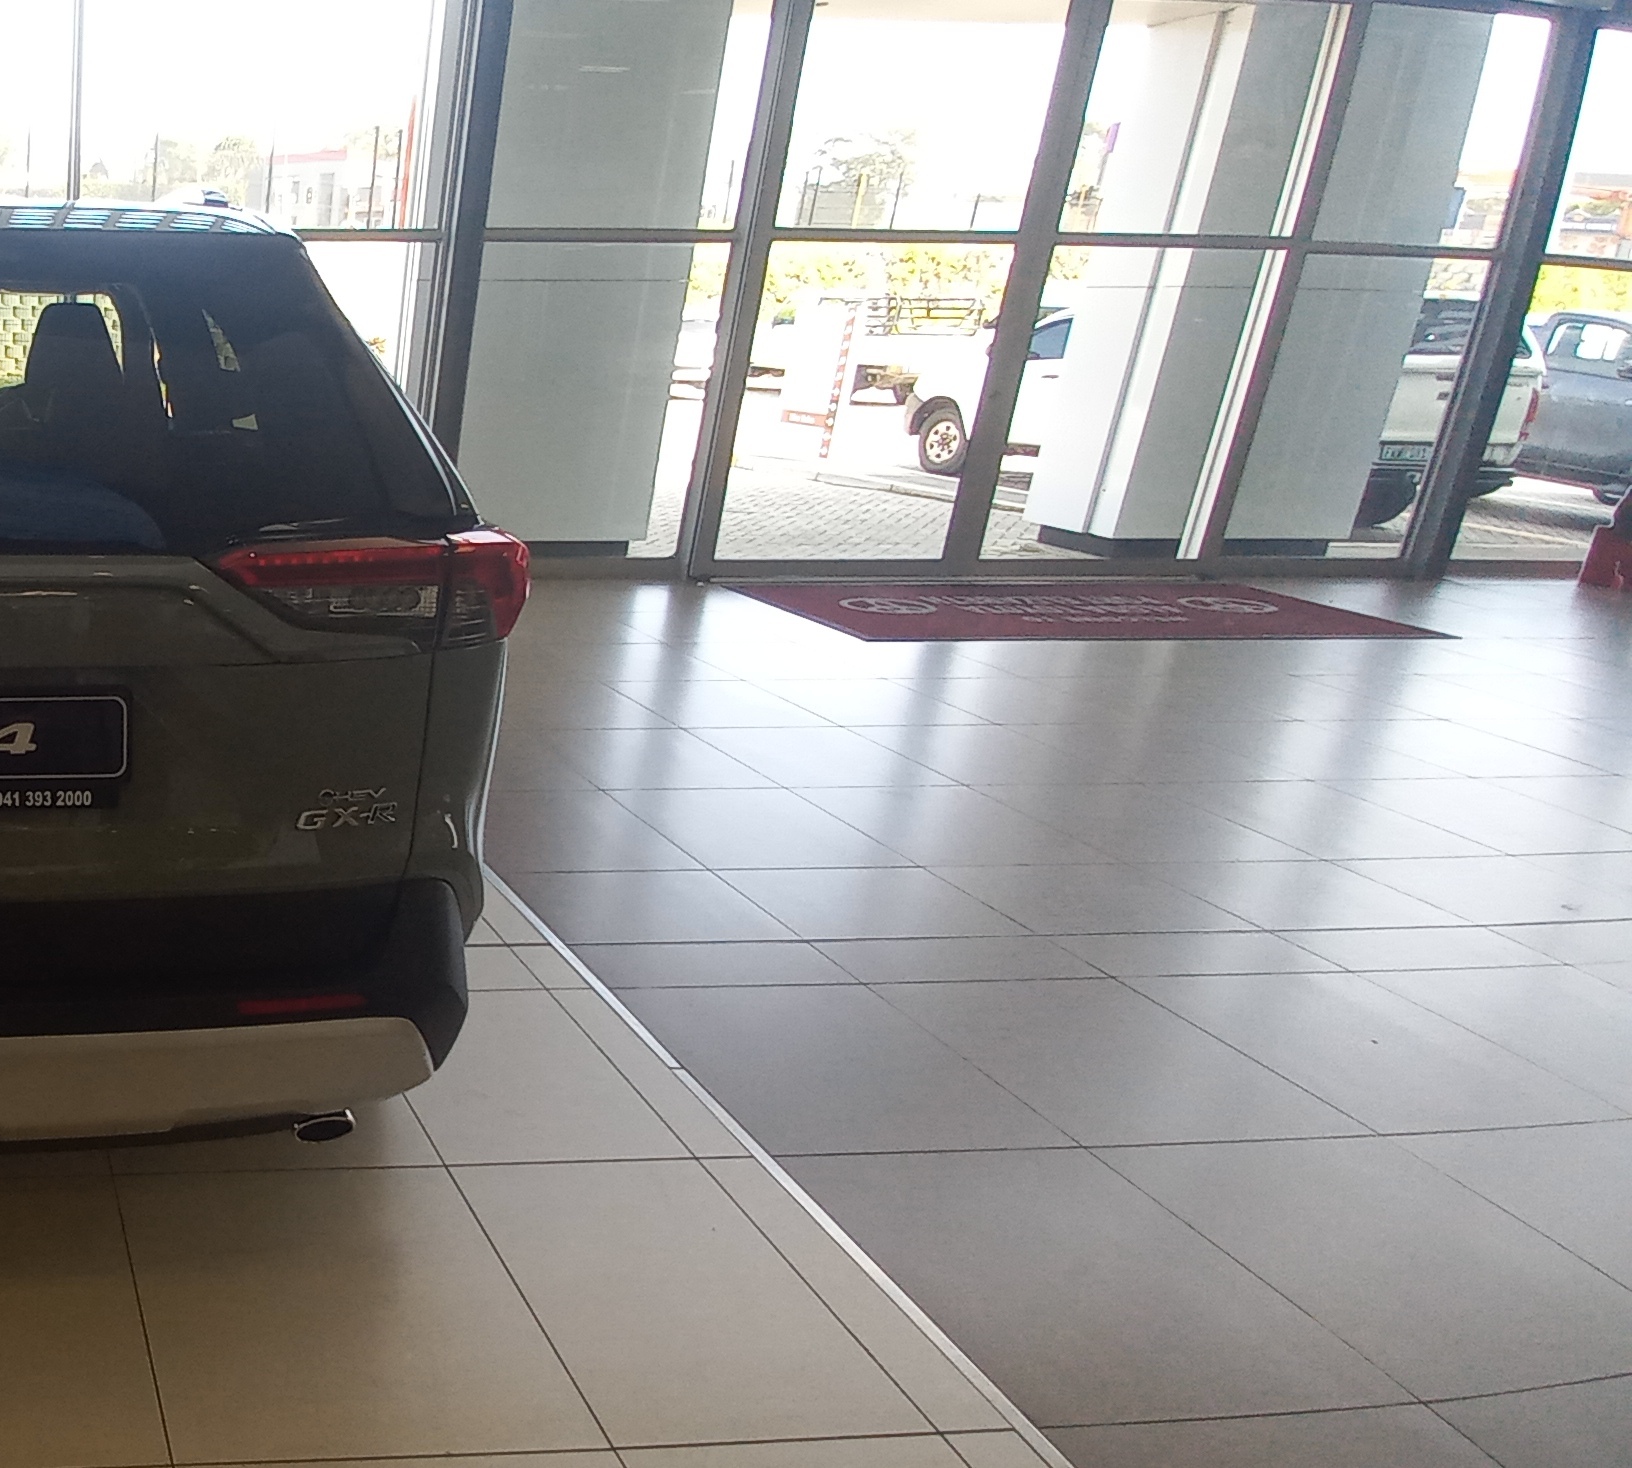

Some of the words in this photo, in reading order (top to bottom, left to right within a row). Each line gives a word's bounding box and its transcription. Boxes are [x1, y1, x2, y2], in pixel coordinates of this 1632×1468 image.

[25, 790, 52, 806] 393
[55, 790, 92, 806] 2000
[296, 802, 398, 830] GX-R
